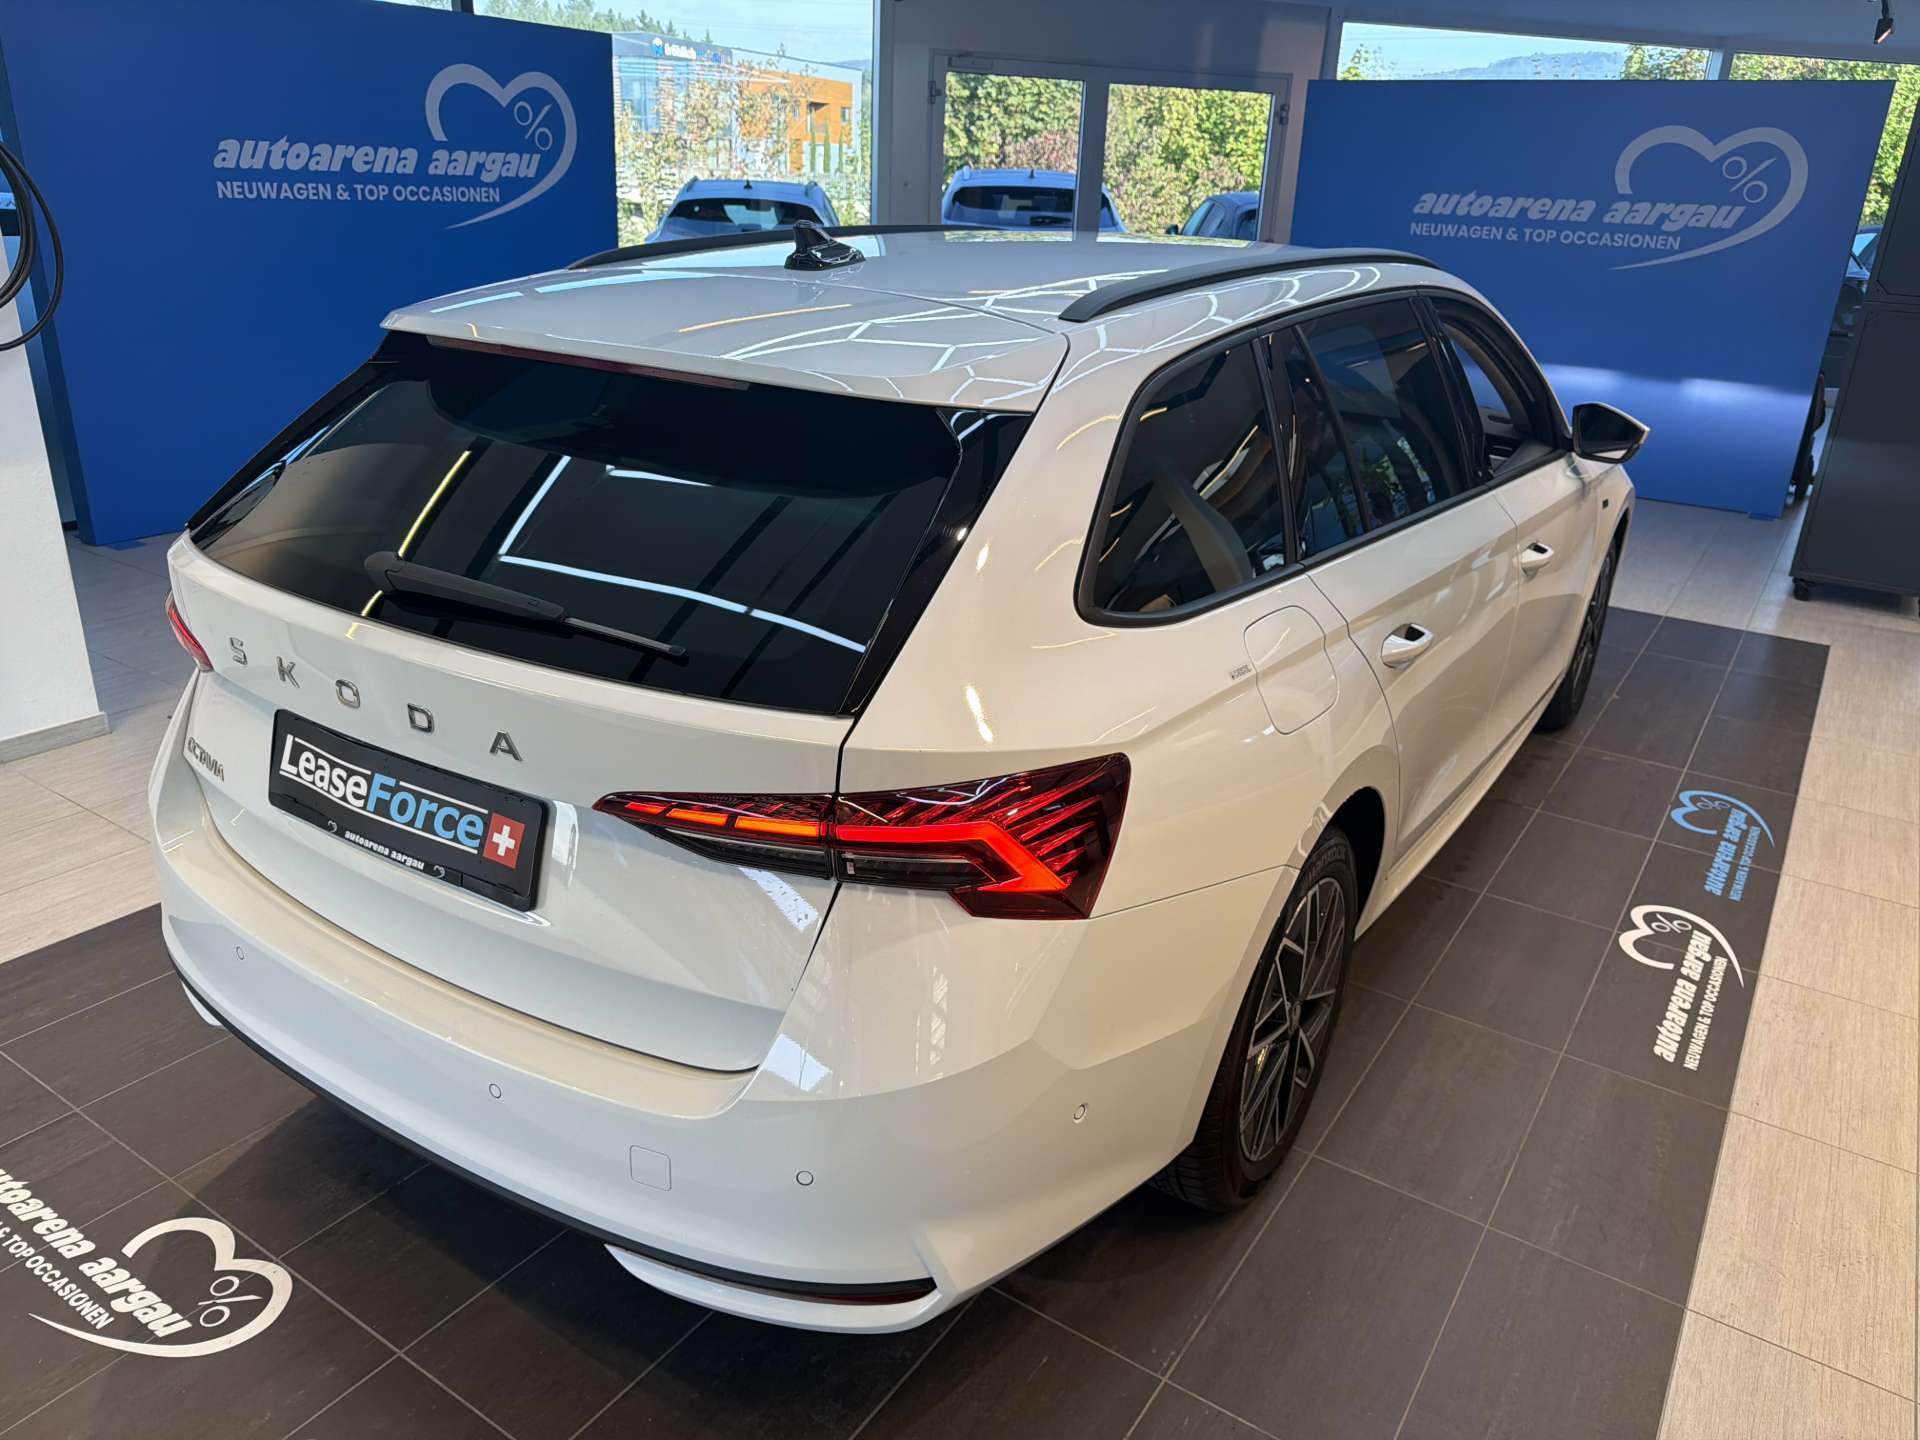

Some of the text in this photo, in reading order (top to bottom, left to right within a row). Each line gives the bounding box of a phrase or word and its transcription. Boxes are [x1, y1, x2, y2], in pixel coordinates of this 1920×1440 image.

[213, 136, 541, 183] autoarena aargau
[216, 180, 500, 203] NEUWAGEN & TOP OCCASIONEN
[1410, 222, 1681, 251] NEUWAGEN & TOP OCCASIONEN
[1413, 189, 1747, 232] autoarena aargau
[188, 736, 225, 781] OCTAVIA
[279, 734, 485, 848] LeaseForce
[344, 830, 425, 870] autoarena aargau
[1704, 808, 1748, 896] autoarena aargau
[1653, 930, 1712, 1063] autoarena aargau
[1683, 956, 1728, 1071] NEUWAGEN & TOP OCCASIONEN
[2, 1234, 35, 1258] TOP
[25, 1255, 115, 1330] OCCASIONEN
[79, 1257, 193, 1338] aargau
